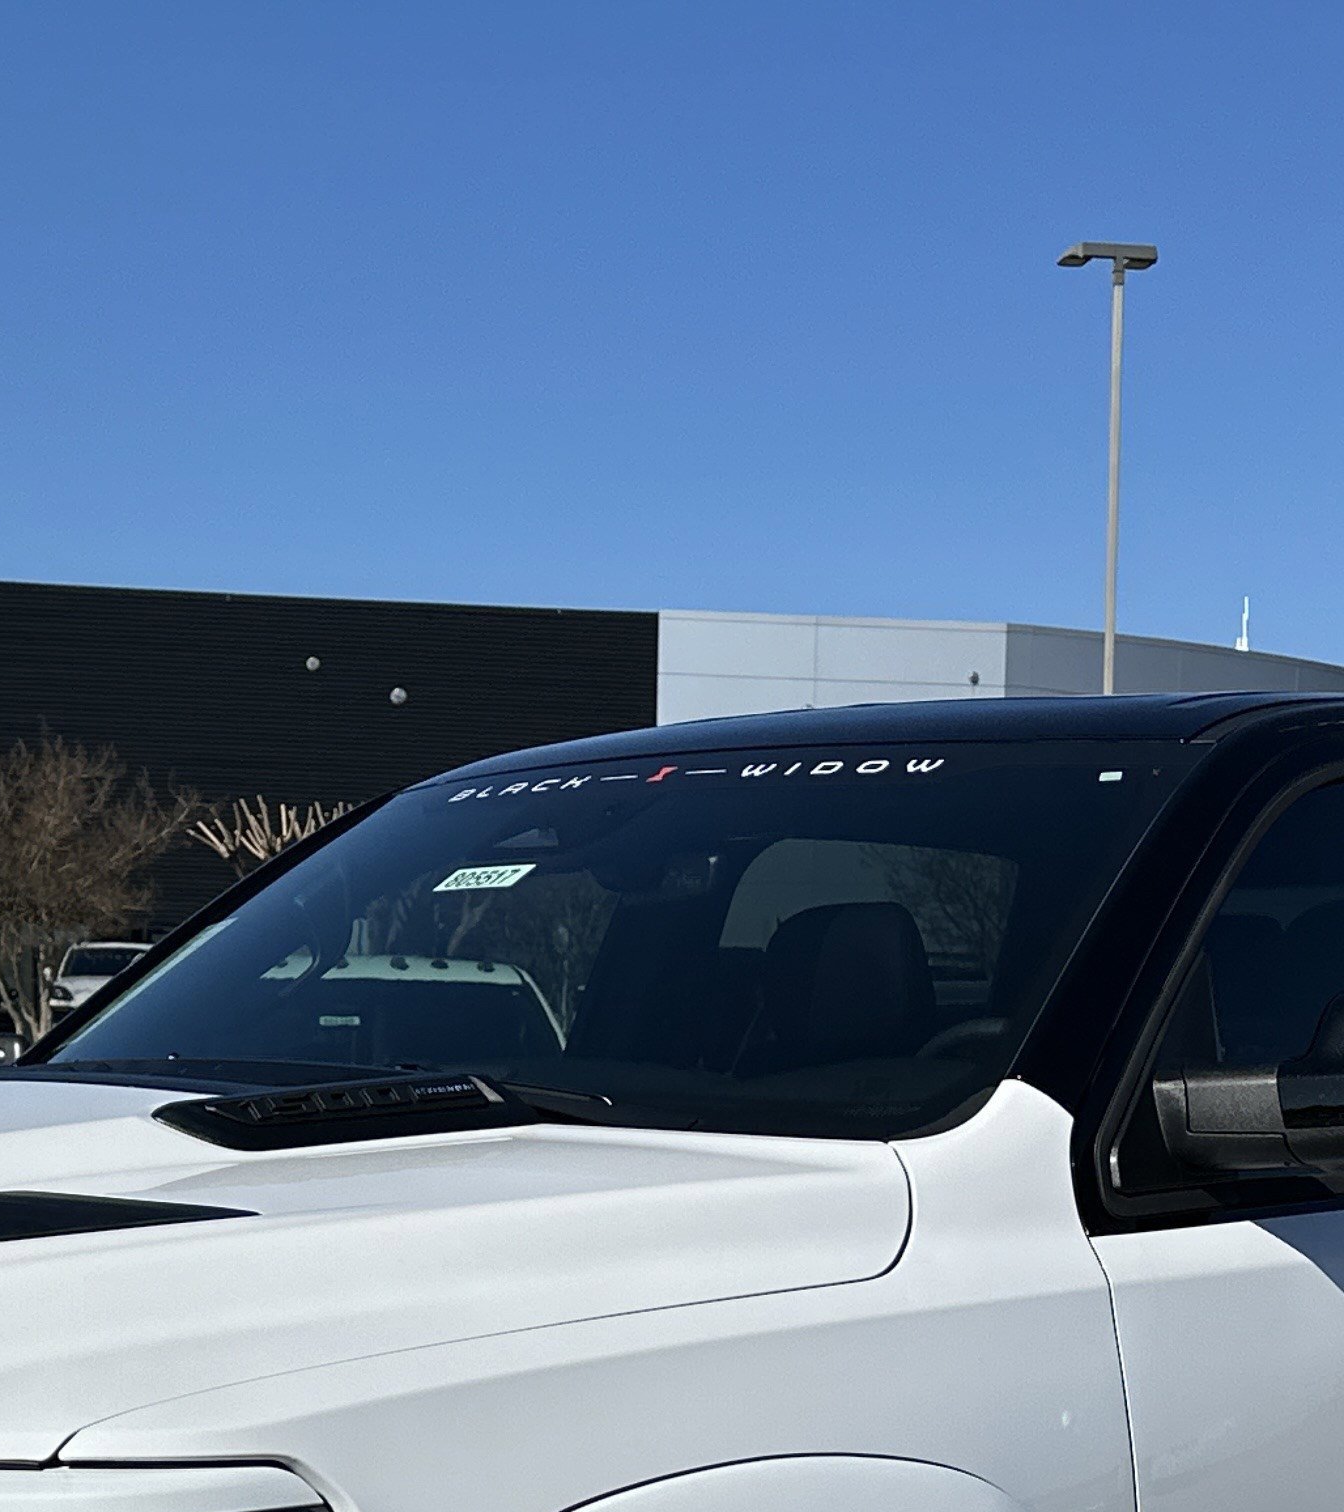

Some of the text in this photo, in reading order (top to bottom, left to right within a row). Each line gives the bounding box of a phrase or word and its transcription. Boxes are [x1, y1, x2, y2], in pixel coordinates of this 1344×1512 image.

[448, 758, 945, 803] BLACK WIDOW
[238, 1086, 401, 1122] 1500
